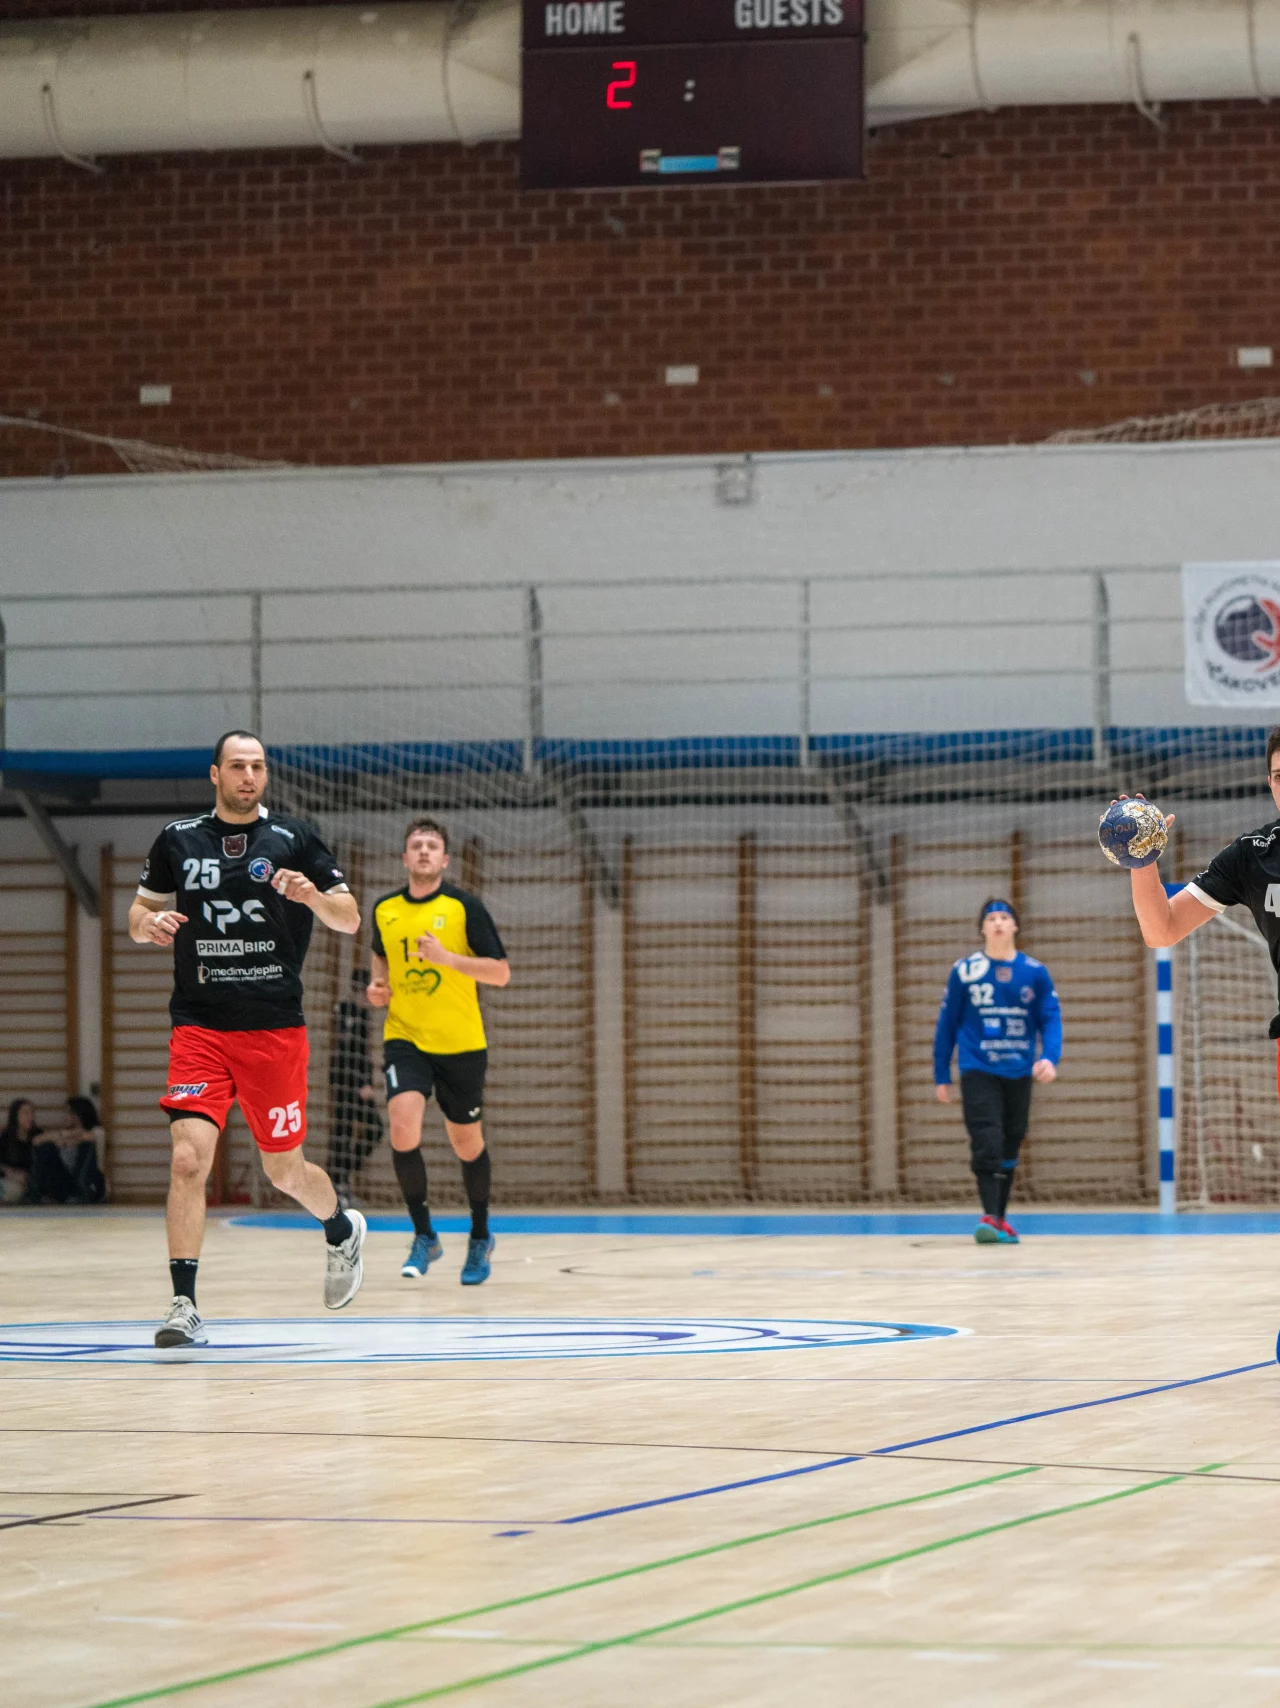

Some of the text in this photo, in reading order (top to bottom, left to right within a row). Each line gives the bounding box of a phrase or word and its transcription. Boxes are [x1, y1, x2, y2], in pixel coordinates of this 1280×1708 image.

[546, 2, 625, 36] HOME
[734, 0, 844, 28] GUESTS
[606, 61, 636, 109] 2
[182, 858, 221, 890] 25
[198, 941, 276, 953] PRIMA BIRO
[968, 982, 994, 1006] 32
[268, 1101, 301, 1138] 25
